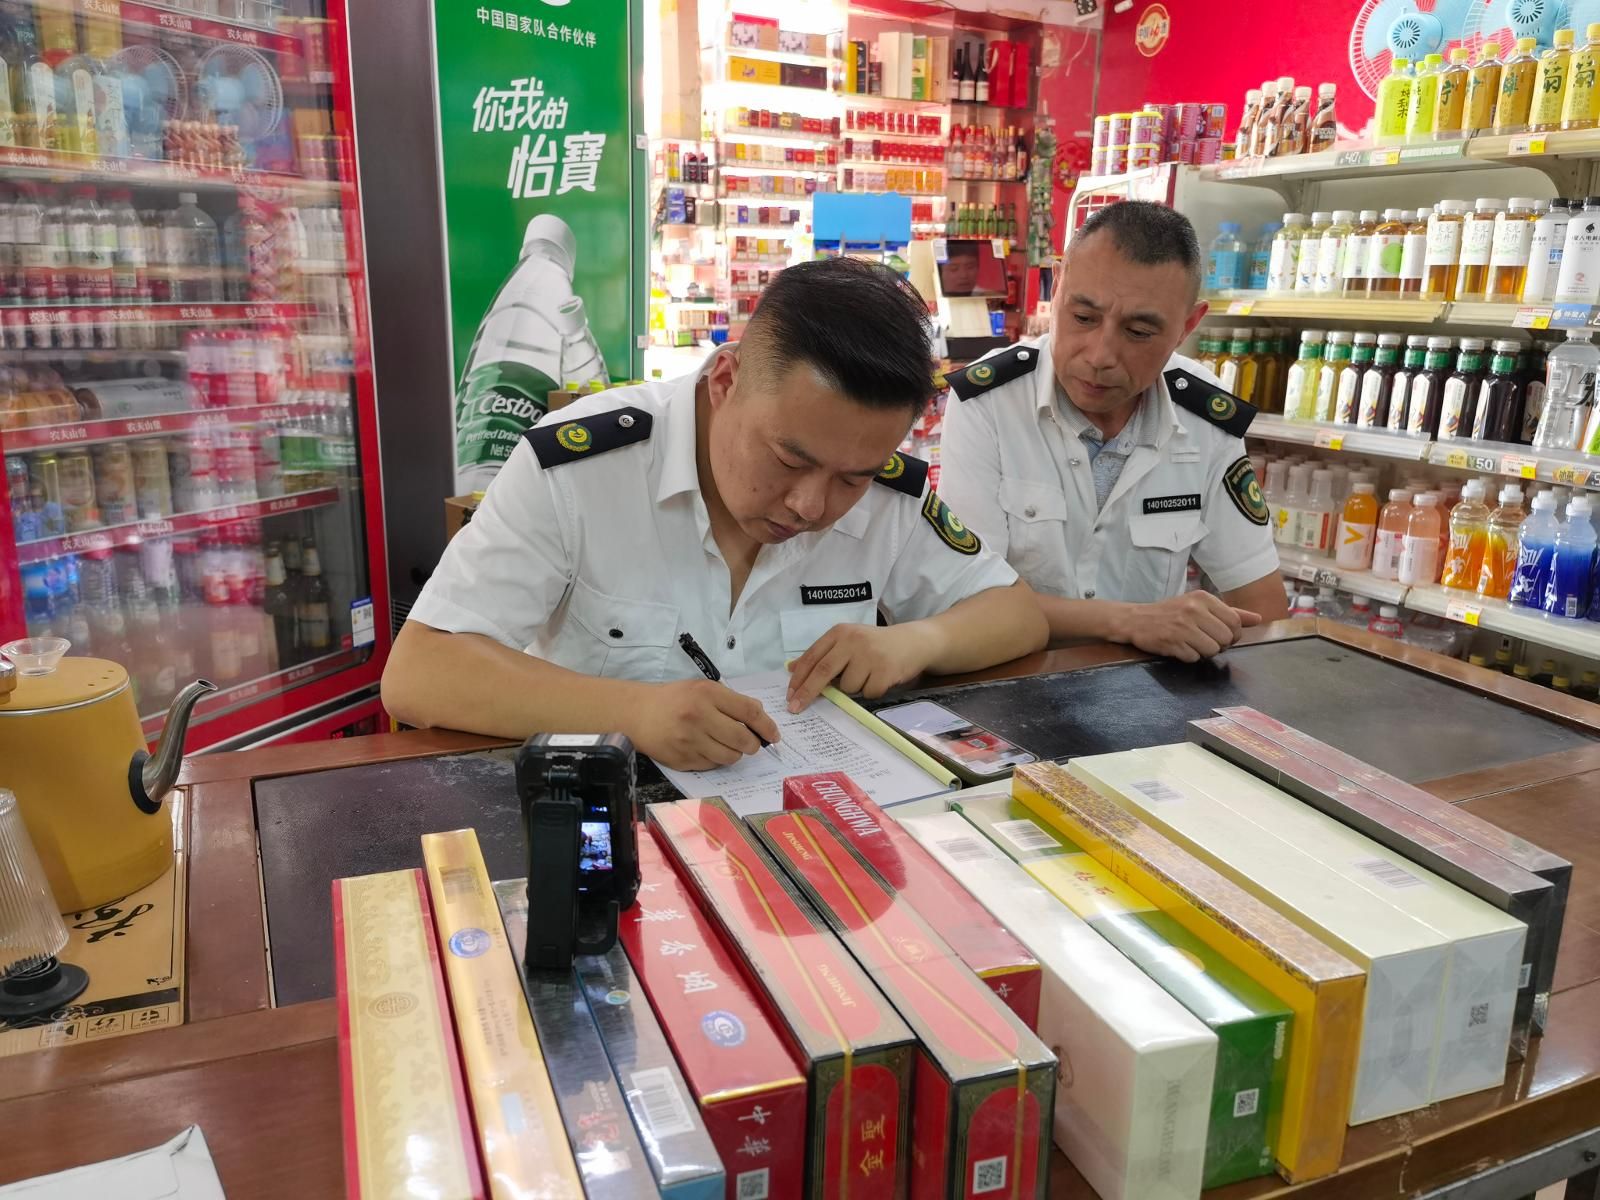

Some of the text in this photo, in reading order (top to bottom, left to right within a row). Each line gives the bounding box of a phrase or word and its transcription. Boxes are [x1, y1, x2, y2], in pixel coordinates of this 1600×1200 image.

[476, 6, 597, 48] 中国国家队合作伙伴
[472, 76, 568, 132] 你我的
[507, 131, 606, 198] 怡寶
[1147, 498, 1196, 509] 14010252011
[806, 585, 868, 602] 14010252014
[811, 780, 882, 837] CHUNGHWA
